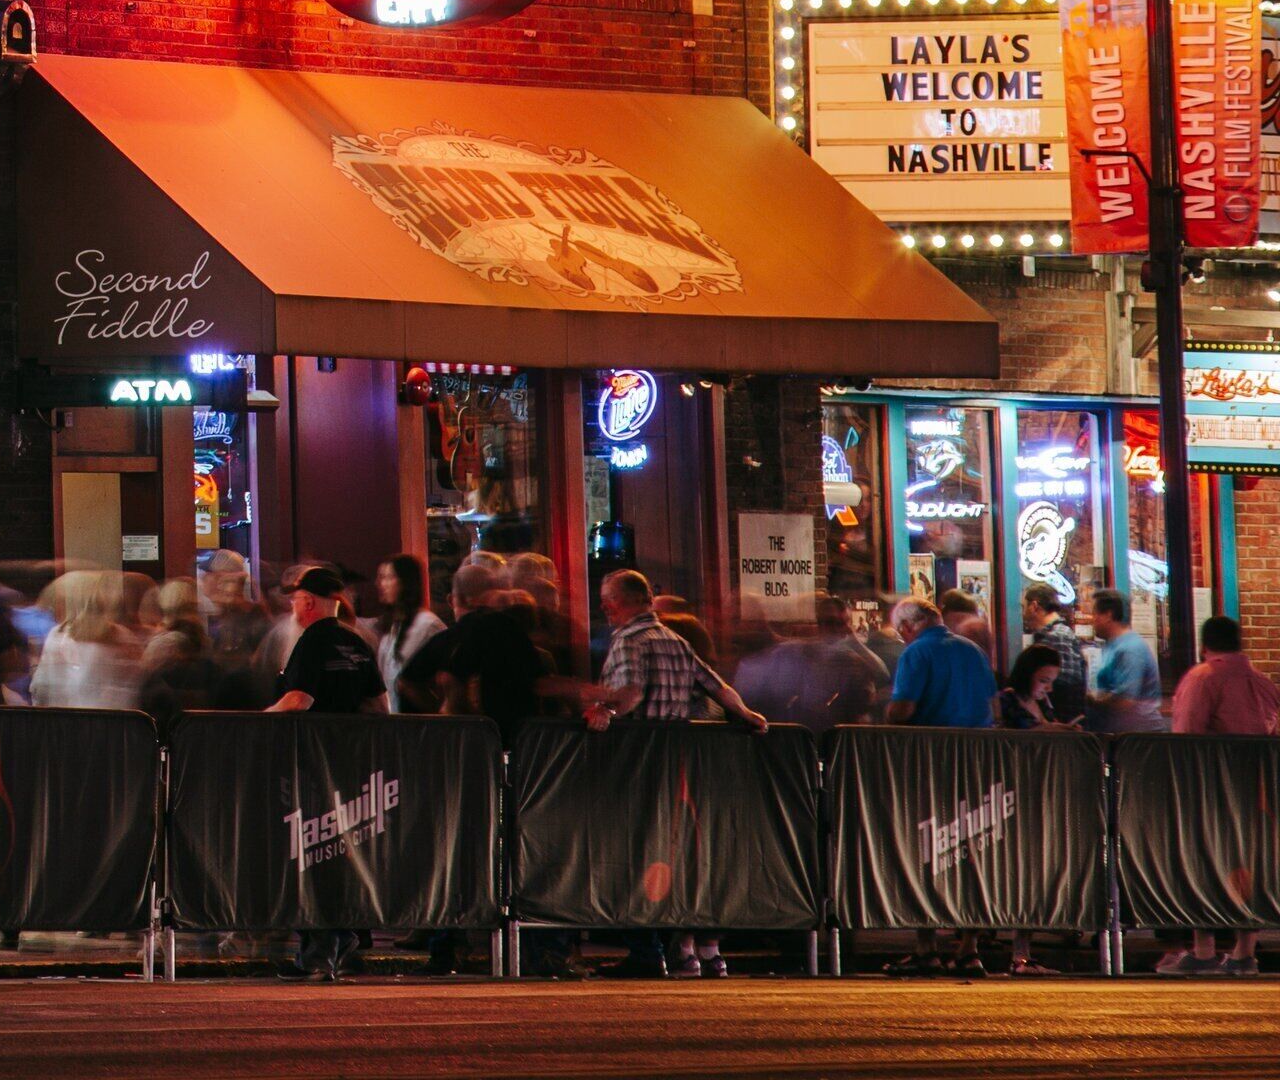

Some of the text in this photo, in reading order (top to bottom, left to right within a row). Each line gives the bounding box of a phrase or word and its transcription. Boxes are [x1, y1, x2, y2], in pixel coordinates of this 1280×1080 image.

[890, 34, 1031, 66] LAYLA'S
[1223, 0, 1255, 111] FESTIVAL
[881, 70, 1044, 102] WELCOME
[940, 108, 977, 137] TO
[1179, 0, 1217, 220] NASHVILLE
[1089, 44, 1135, 223] WELCOME
[1223, 119, 1252, 178] FILM
[448, 140, 490, 160] THE
[887, 142, 1053, 174] NASHVILLE
[54, 249, 212, 298] Second
[53, 295, 215, 345] Fiddle
[110, 379, 193, 402] ATM
[768, 535, 786, 552] THE
[741, 558, 812, 575] ROBERT MOORE
[764, 581, 790, 597] BLDG.
[283, 769, 399, 873] Nashville
[305, 839, 346, 869] MUSIC
